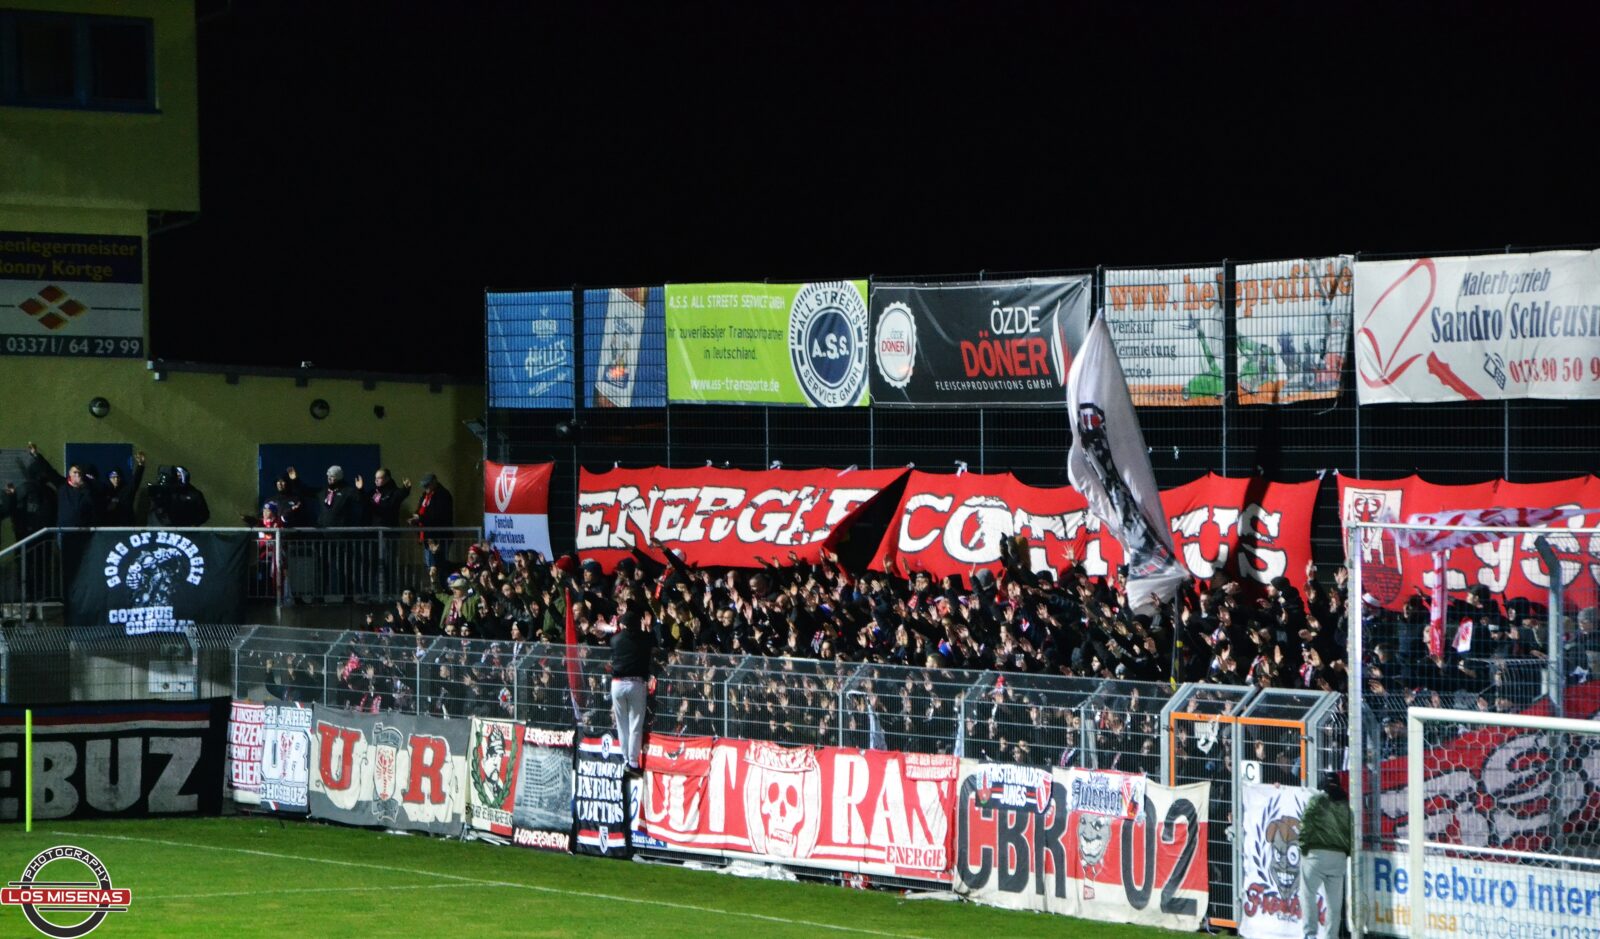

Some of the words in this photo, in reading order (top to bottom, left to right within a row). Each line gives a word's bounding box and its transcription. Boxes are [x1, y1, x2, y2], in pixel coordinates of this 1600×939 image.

[691, 295, 704, 308] ALL
[707, 295, 738, 308] STREETS
[742, 295, 768, 309] SERVICE
[797, 303, 815, 330] ALL
[815, 290, 860, 325] STREETS
[990, 300, 1041, 335] ÖZDE
[1431, 304, 1503, 343] Sandro
[69, 338, 89, 353] 64
[94, 339, 114, 354] 29
[120, 340, 140, 354] 99
[812, 333, 850, 360] A.S.S.
[960, 330, 1050, 378] DÖNER
[1562, 357, 1583, 382] 50
[803, 369, 838, 405] SERVICE
[839, 367, 862, 401] GMBH
[935, 380, 1024, 391] FLEISCHPRODUKTIONS
[1027, 380, 1053, 390] GMBH
[104, 542, 129, 588] SONS
[129, 532, 152, 548] OF
[155, 531, 205, 586] ENERGIE
[109, 606, 174, 624] COTTBUS
[1245, 763, 1255, 781] C
[887, 845, 944, 867] ENERGIE
[1374, 858, 1518, 908] Resebüro
